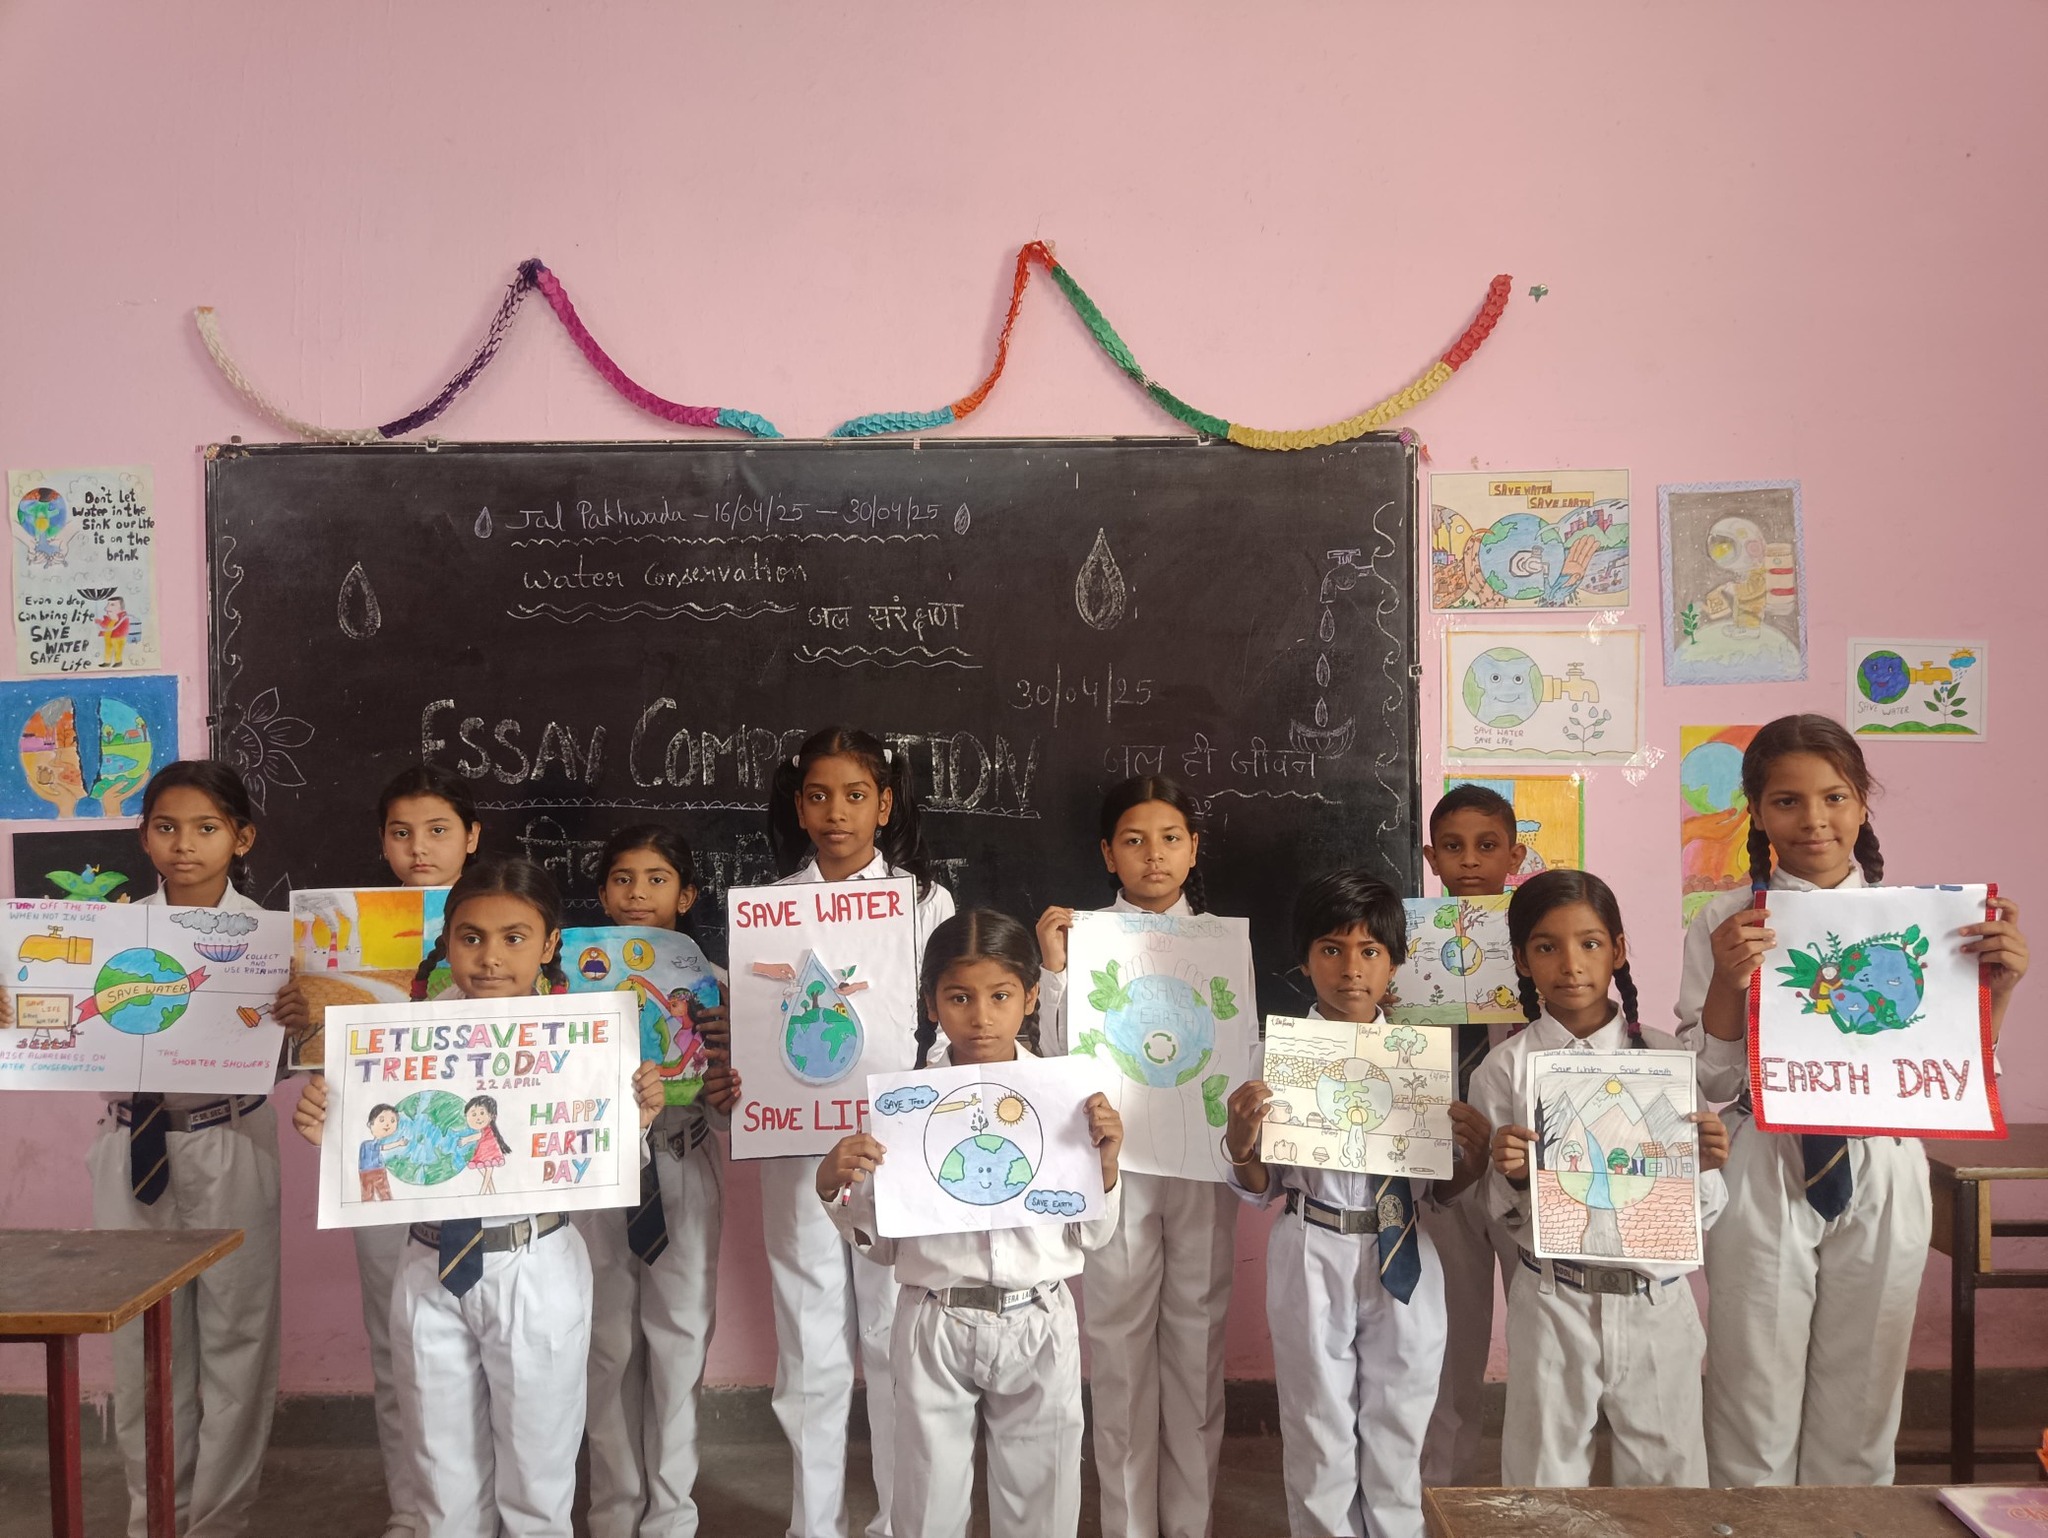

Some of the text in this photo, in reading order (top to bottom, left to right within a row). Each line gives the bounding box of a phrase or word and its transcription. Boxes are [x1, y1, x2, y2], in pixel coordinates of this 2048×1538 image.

[1494, 484, 1552, 495] SAVE WATER
[112, 505, 122, 516] in
[124, 503, 146, 517] the
[1529, 497, 1591, 509] SAVE EARTH
[505, 501, 566, 531] Jal
[577, 497, 687, 531] Pakhwada
[843, 495, 943, 530] 30/04/25
[116, 521, 136, 529] our
[94, 531, 150, 546] is on the
[644, 552, 807, 589] Conservation
[57, 597, 64, 606] a
[67, 594, 85, 608] drop
[40, 610, 68, 626] bring
[808, 605, 852, 630] जल
[46, 640, 89, 655] WATER
[61, 658, 92, 671] Life
[1008, 662, 1155, 728] 30/04/25
[1857, 701, 1910, 715] SAVE WATER
[1474, 725, 1524, 738] SAVE WATER
[1475, 736, 1491, 745] SAVE
[1104, 732, 1317, 778] जल ही जीवन
[40, 902, 59, 910] OFF
[63, 902, 81, 911] THE
[86, 903, 107, 911] TAP
[736, 890, 904, 928] SAVE WATER
[9, 912, 97, 922] WHEN NOT IN USE
[1146, 930, 1174, 951] DAY
[107, 984, 188, 1004] SAVE WATER
[1141, 978, 1193, 1010] SAVE
[0, 1052, 24, 1060] AISE
[92, 1053, 107, 1061] ON
[158, 1049, 179, 1057] TAKE
[0, 1063, 105, 1072] ATER CONSERVATION
[354, 1050, 570, 1083] TREES TODAY
[476, 1078, 541, 1091] 22 APRIL
[1761, 1057, 1970, 1101] EARTH DAY
[530, 1098, 611, 1126] HAPPY
[884, 1099, 904, 1110] SAVE
[743, 1099, 869, 1134] SAVE LIF
[531, 1127, 610, 1158] EARTH
[543, 1157, 591, 1184] DAY
[1031, 1198, 1074, 1208] SAVE EARTH
